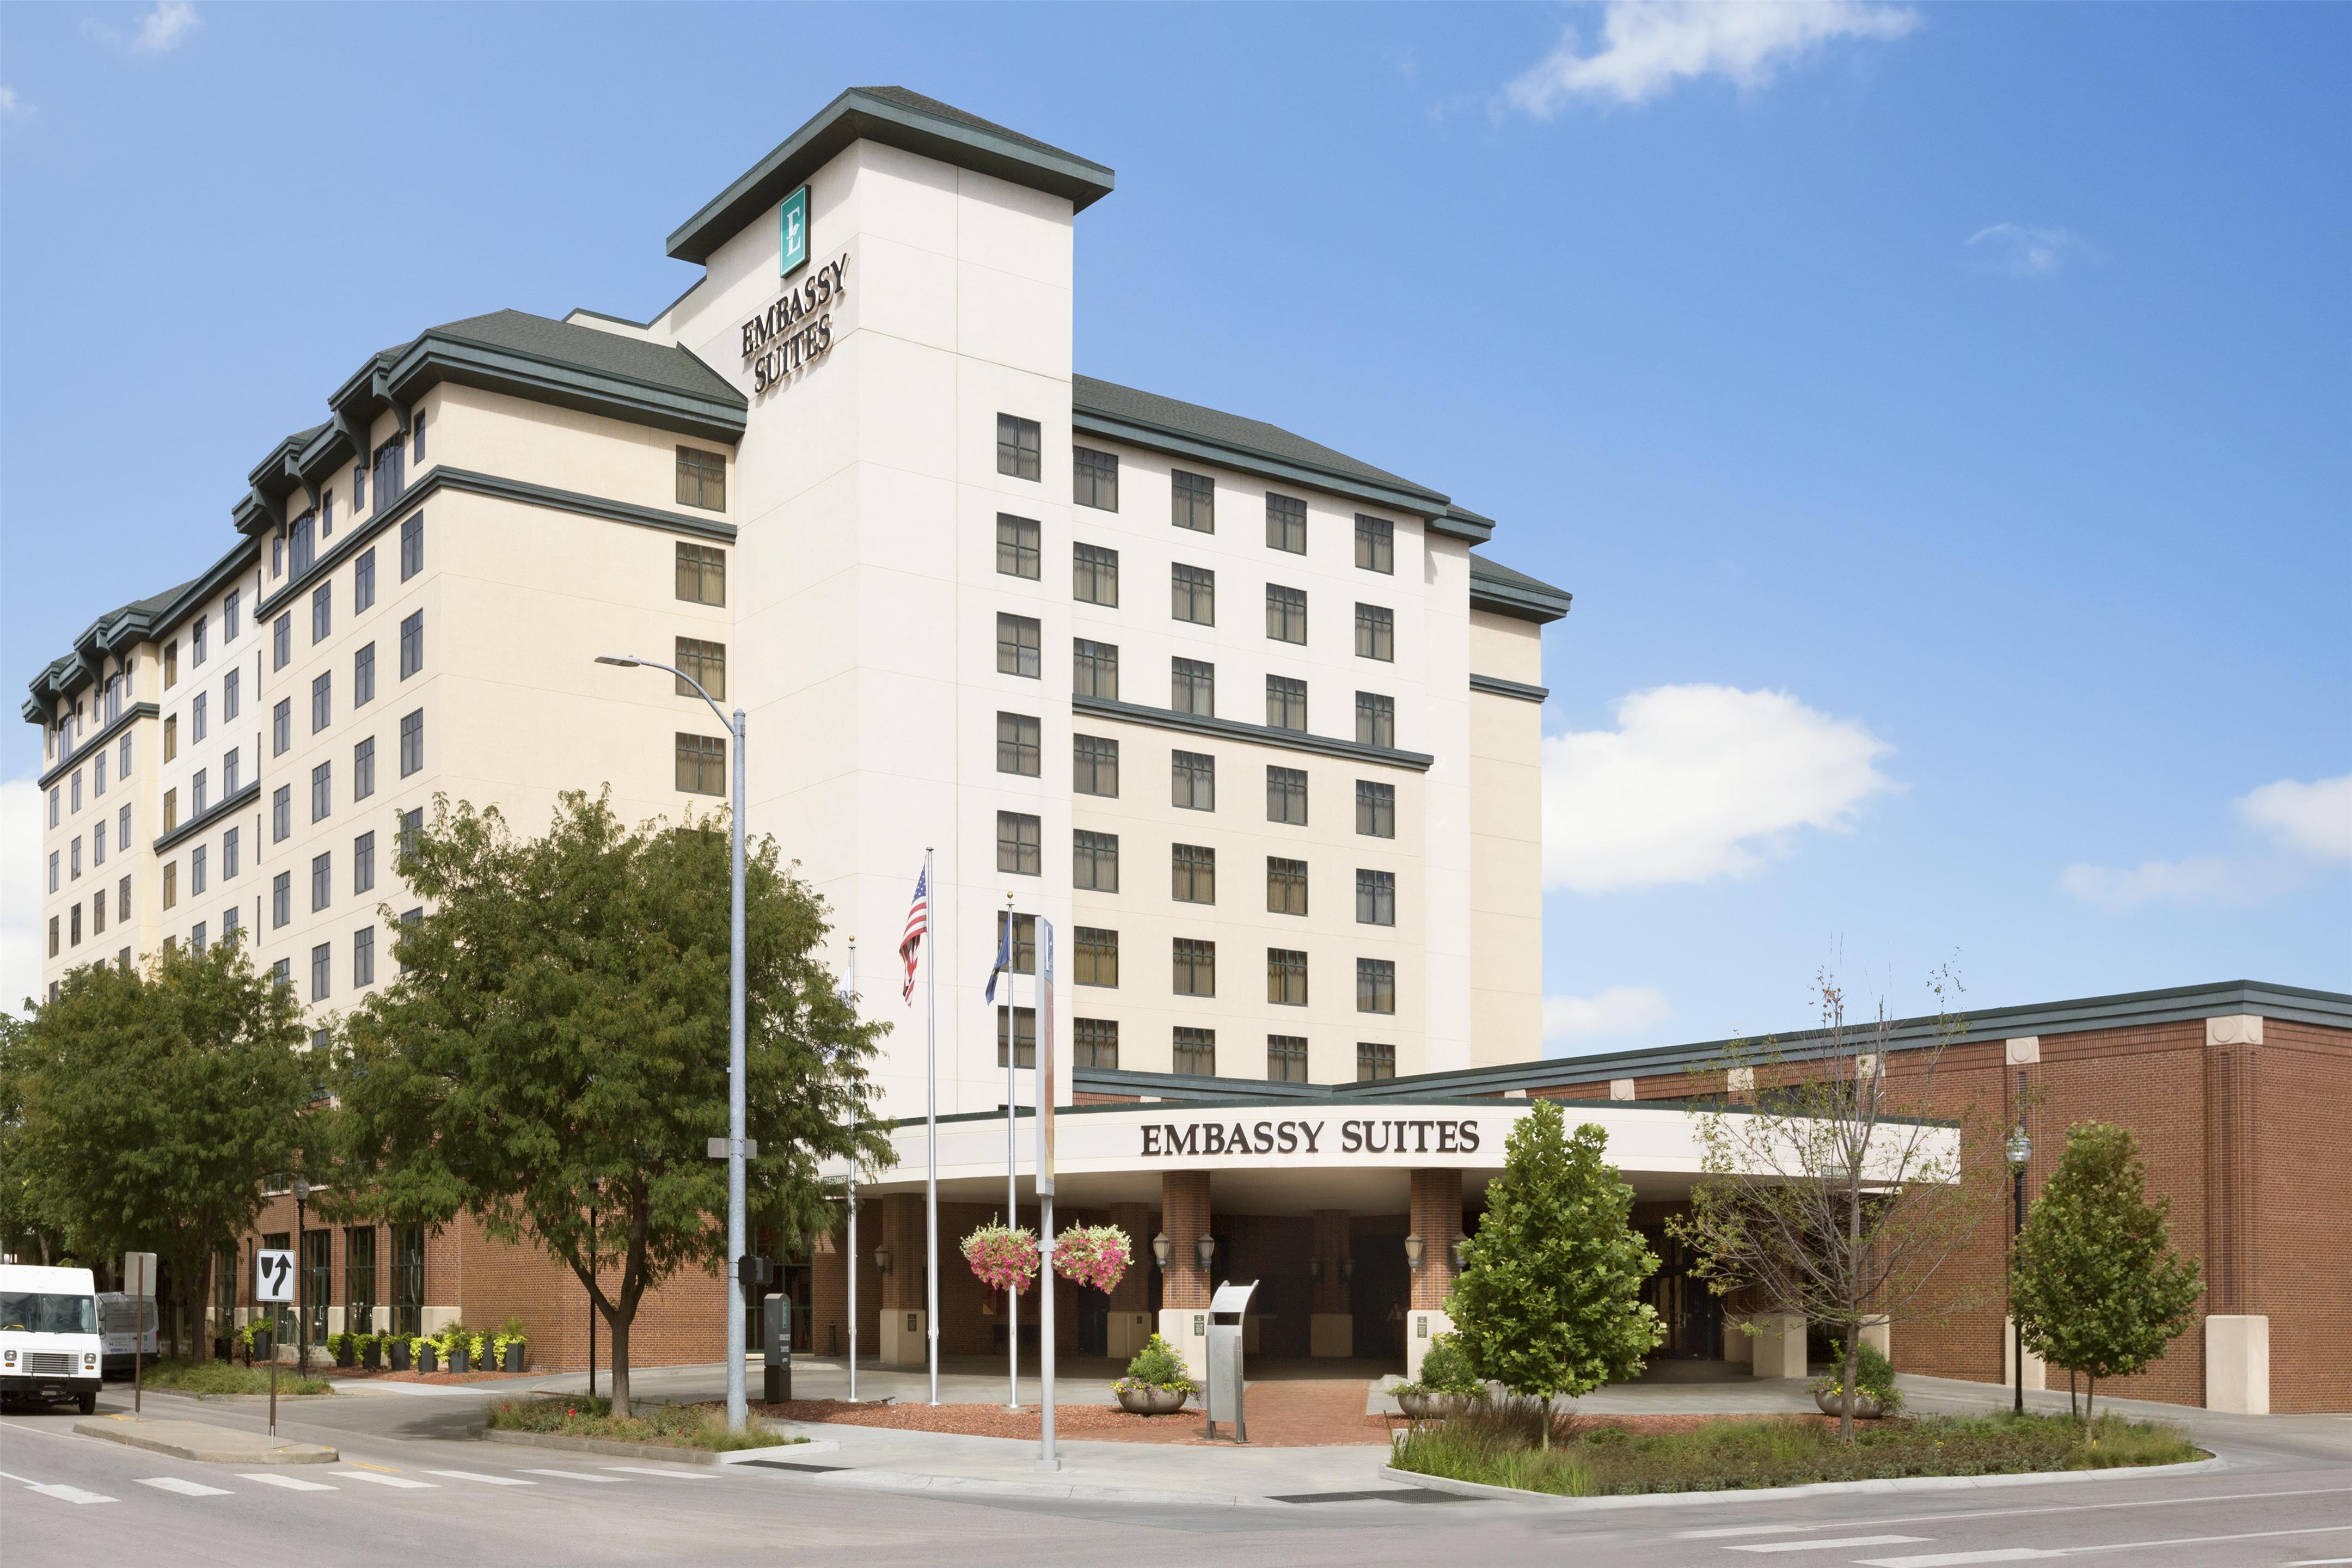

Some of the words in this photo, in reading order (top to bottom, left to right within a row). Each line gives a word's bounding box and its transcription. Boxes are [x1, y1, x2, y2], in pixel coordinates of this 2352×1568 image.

[786, 206, 800, 257] E
[742, 253, 849, 358] EMBASSY
[755, 314, 832, 393] SUITES
[1141, 1120, 1325, 1156] EMBASSY
[1342, 1120, 1480, 1154] SUITES
